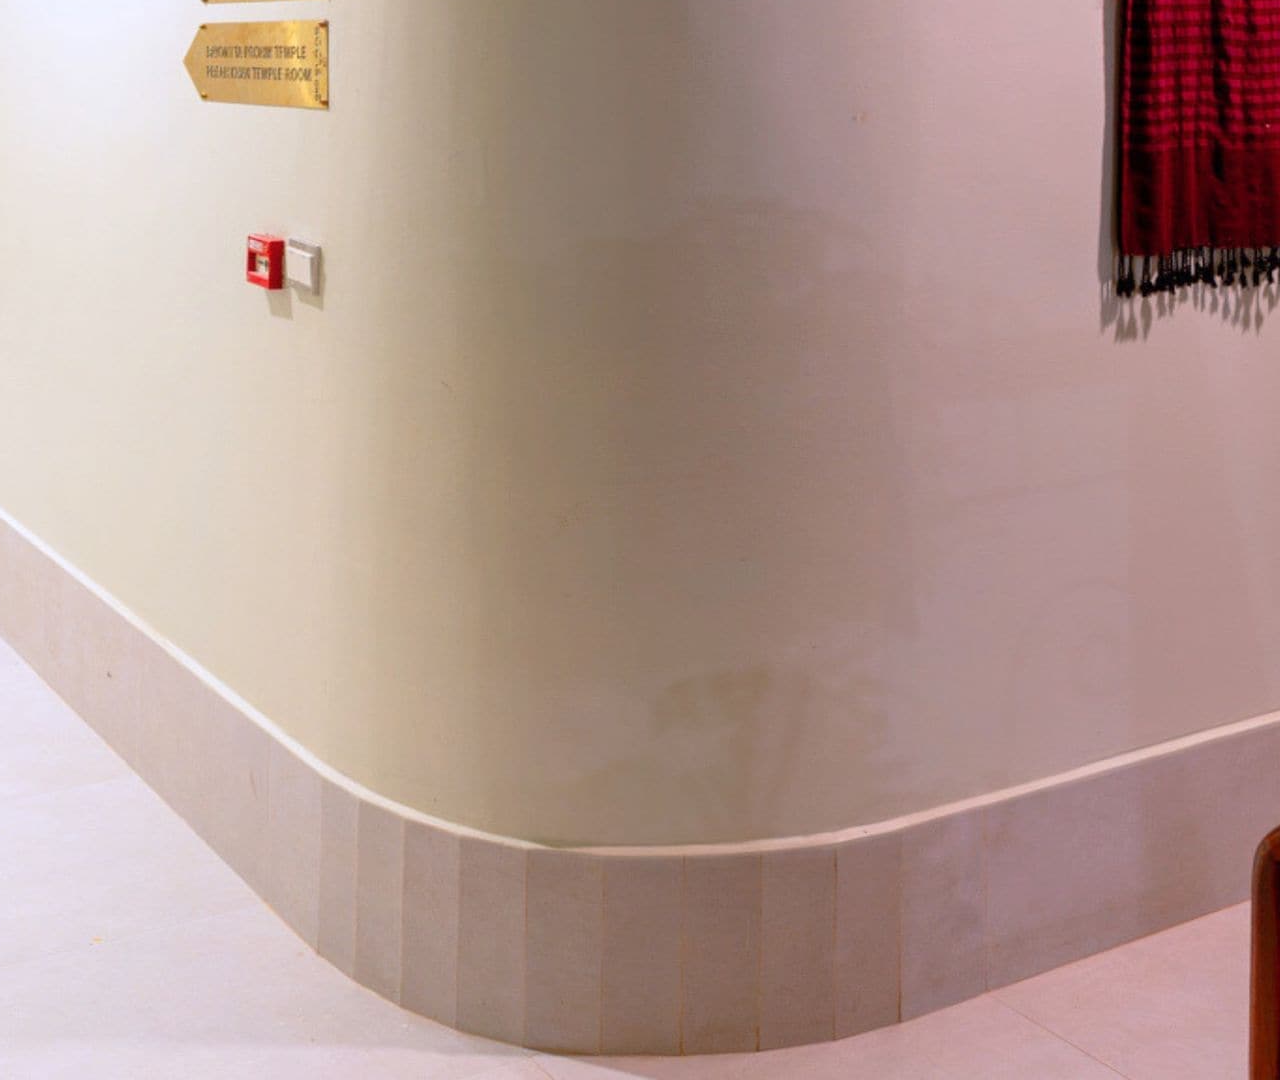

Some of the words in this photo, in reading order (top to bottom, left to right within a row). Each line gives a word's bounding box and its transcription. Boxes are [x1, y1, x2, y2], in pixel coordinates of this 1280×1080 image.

[274, 45, 307, 59] TEMPLE
[252, 67, 282, 80] TEMPLE
[286, 68, 312, 82] ROOM
